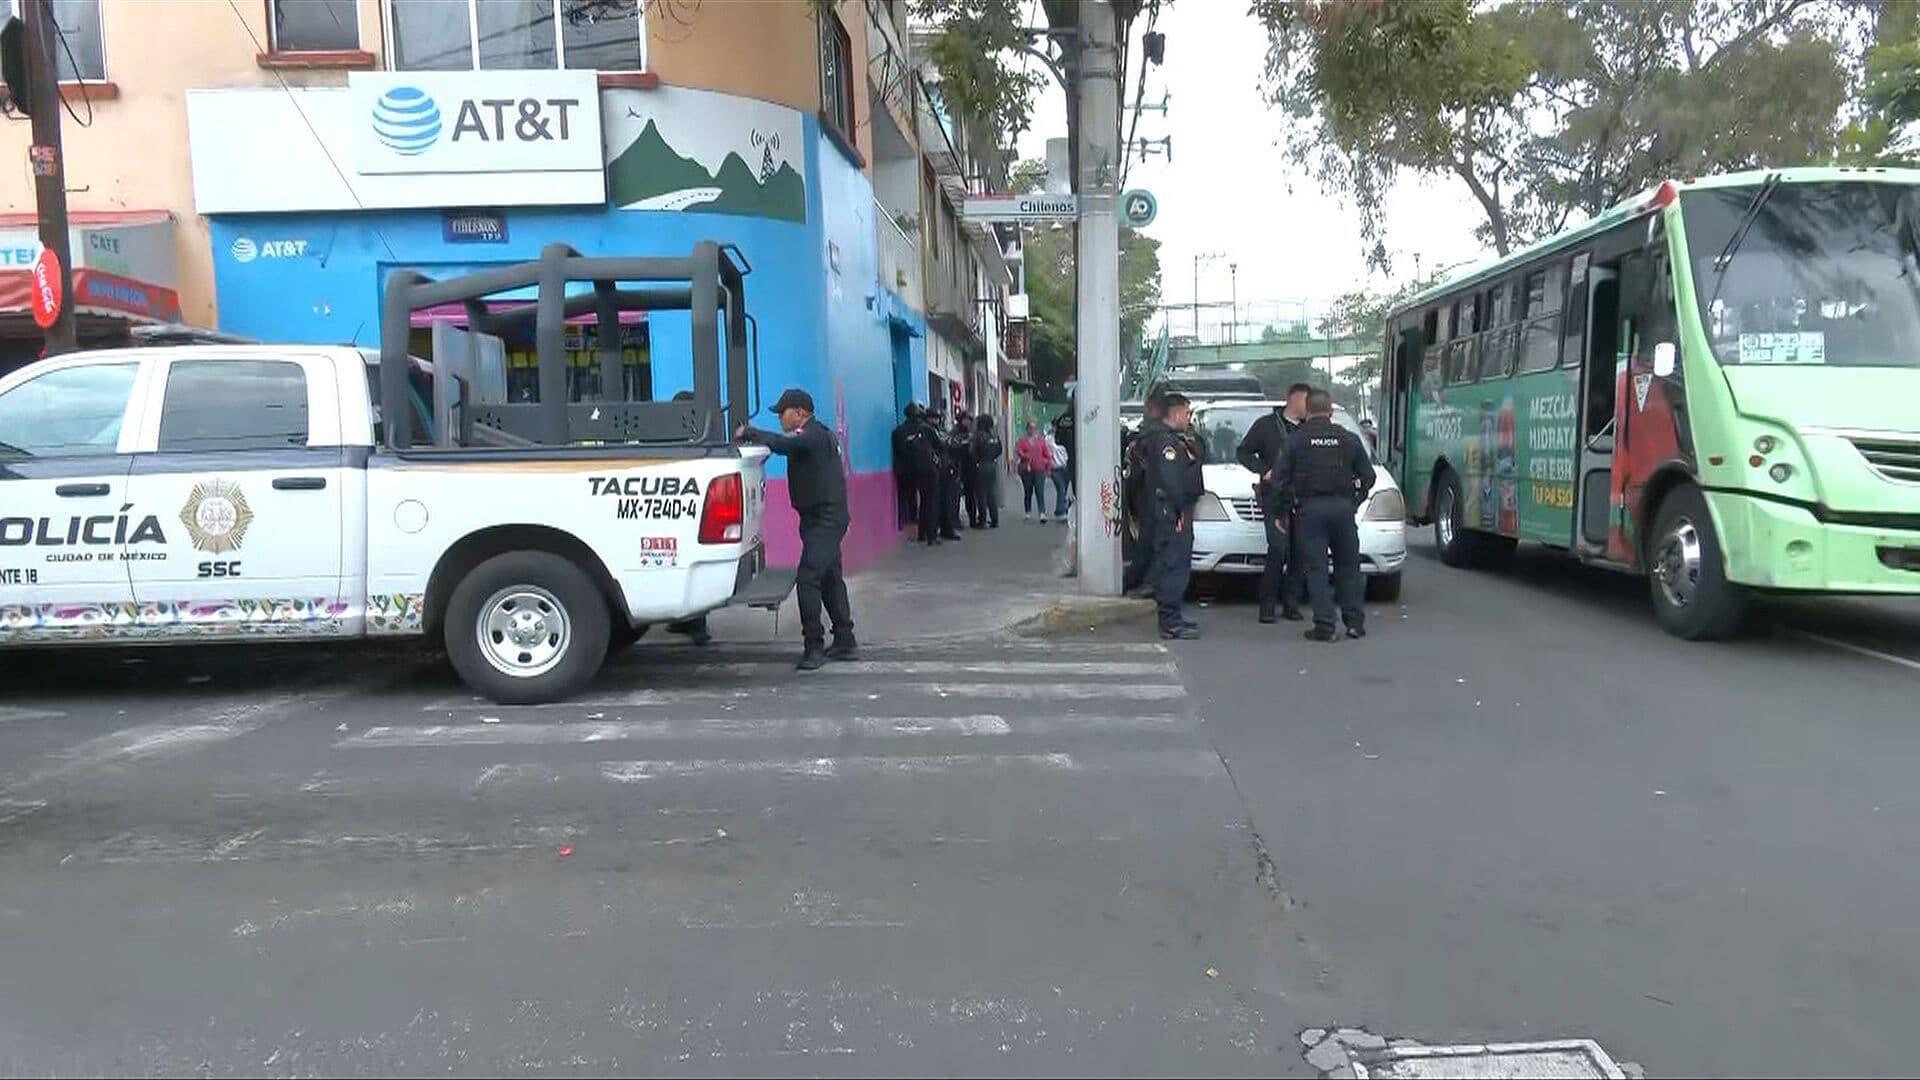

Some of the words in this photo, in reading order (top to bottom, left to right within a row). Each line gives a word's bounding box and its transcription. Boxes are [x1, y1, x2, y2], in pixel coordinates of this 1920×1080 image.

[452, 98, 579, 142] AT&T
[1020, 200, 1074, 213] Chilenos
[261, 240, 308, 257] AT&T
[1529, 395, 1576, 419] MEZCLA
[588, 477, 701, 496] TACUBA
[642, 538, 677, 551] 911
[46, 552, 94, 563] CIUDAD
[98, 552, 114, 562] DE
[26, 568, 38, 584] 18
[198, 560, 242, 577] SSC
